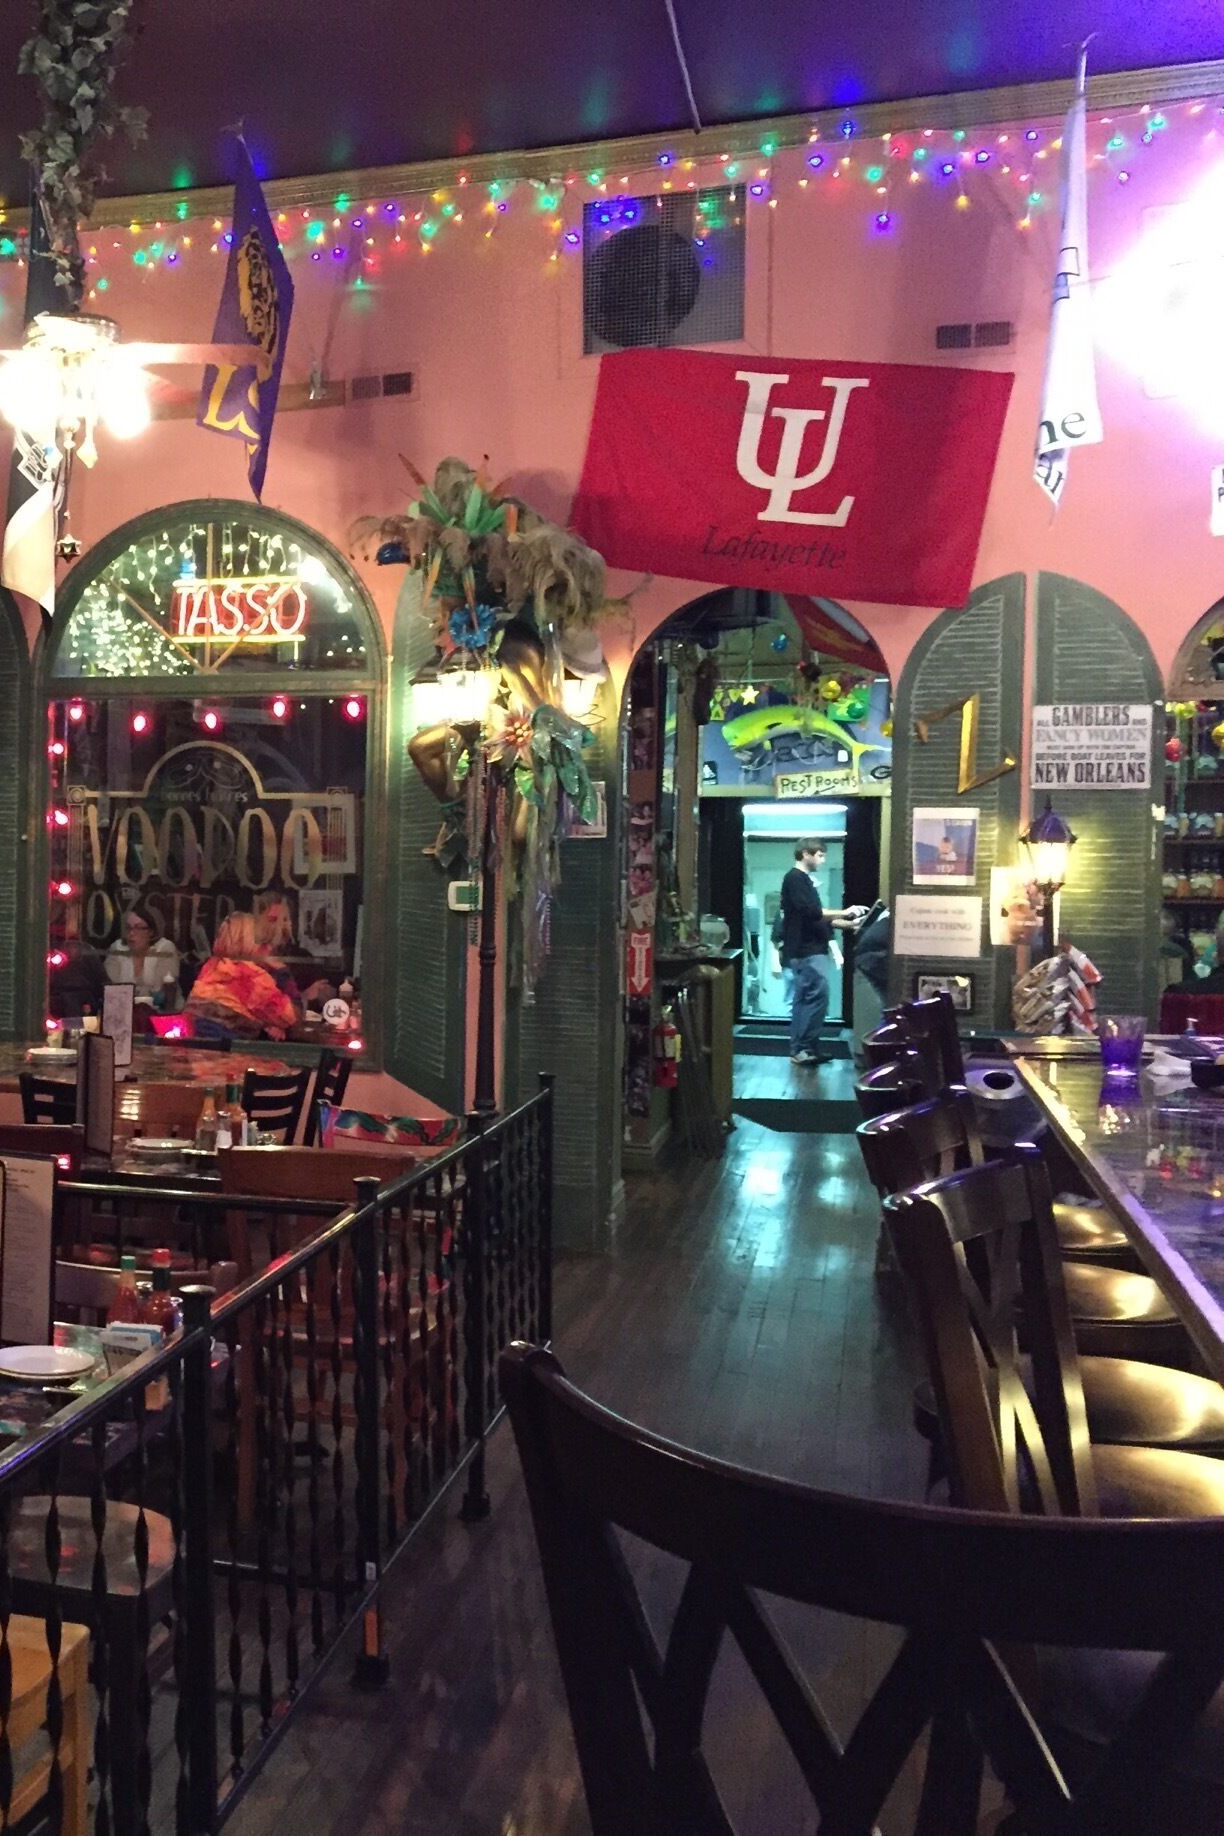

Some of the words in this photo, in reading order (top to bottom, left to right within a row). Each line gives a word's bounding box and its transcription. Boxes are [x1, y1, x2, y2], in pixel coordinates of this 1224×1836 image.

[735, 370, 870, 527] UL
[702, 525, 847, 569] Lafayette
[177, 582, 307, 636] TASSO
[1052, 705, 1130, 727] GAMBLERS
[1035, 728, 1081, 742] FANCY
[1087, 728, 1148, 742] WOMEN
[1035, 752, 1067, 761] BEFORE
[1070, 752, 1093, 761] BOAT
[1095, 752, 1127, 761] LEAVES
[1129, 752, 1147, 761] FOR
[1035, 762, 1070, 783] NEW
[1074, 762, 1145, 783] ORLEANS
[87, 803, 323, 890] VOODOO
[902, 920, 973, 932] EVERYTHING
